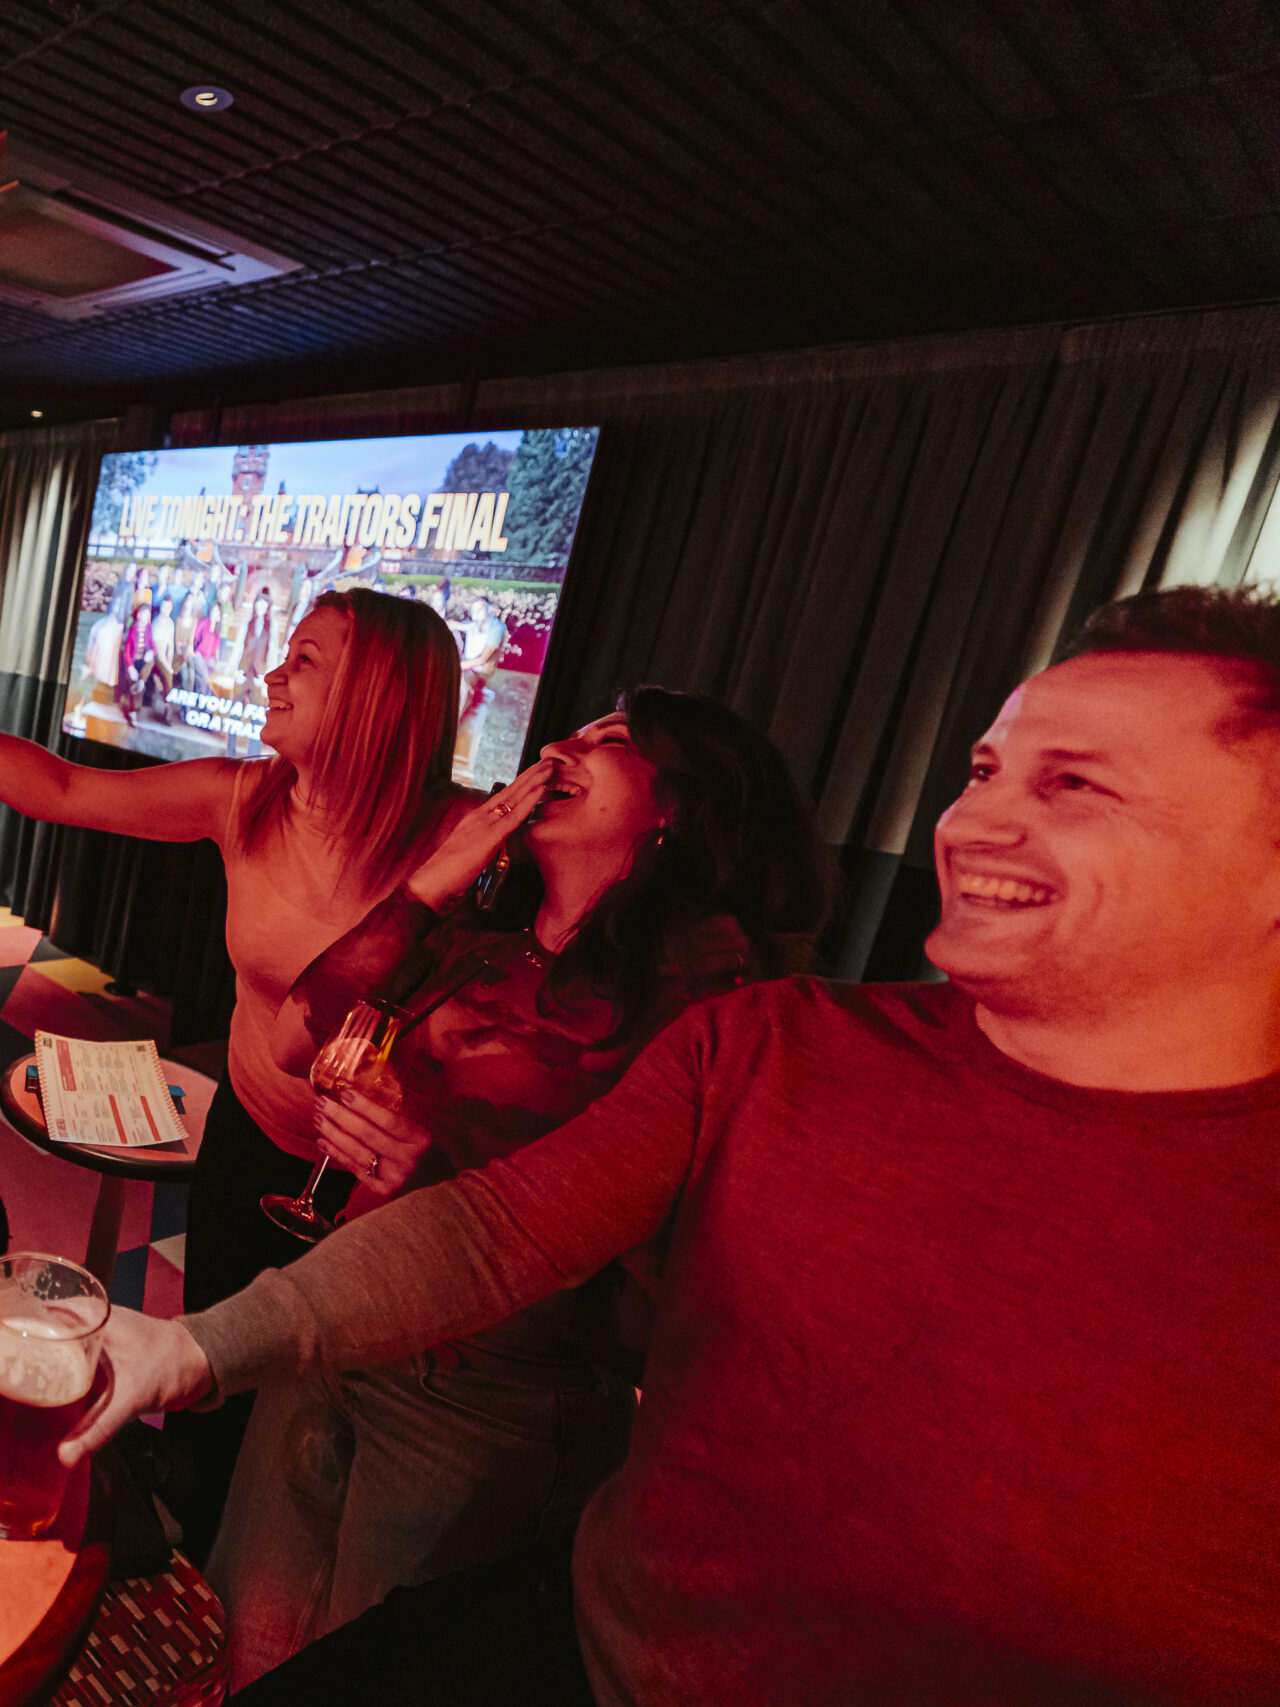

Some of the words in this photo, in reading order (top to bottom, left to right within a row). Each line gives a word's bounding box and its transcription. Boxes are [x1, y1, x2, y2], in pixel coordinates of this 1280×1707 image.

[120, 495, 158, 538] LIVE
[160, 494, 248, 542] TONIGHT:
[249, 494, 293, 545] THE
[293, 493, 420, 550] TRAITORS
[418, 492, 509, 553] FINAL
[166, 688, 198, 707] ARE
[198, 694, 232, 714] YOU
[230, 701, 244, 718] A
[243, 703, 268, 723] FA
[186, 710, 211, 728] OR
[208, 715, 222, 732] A
